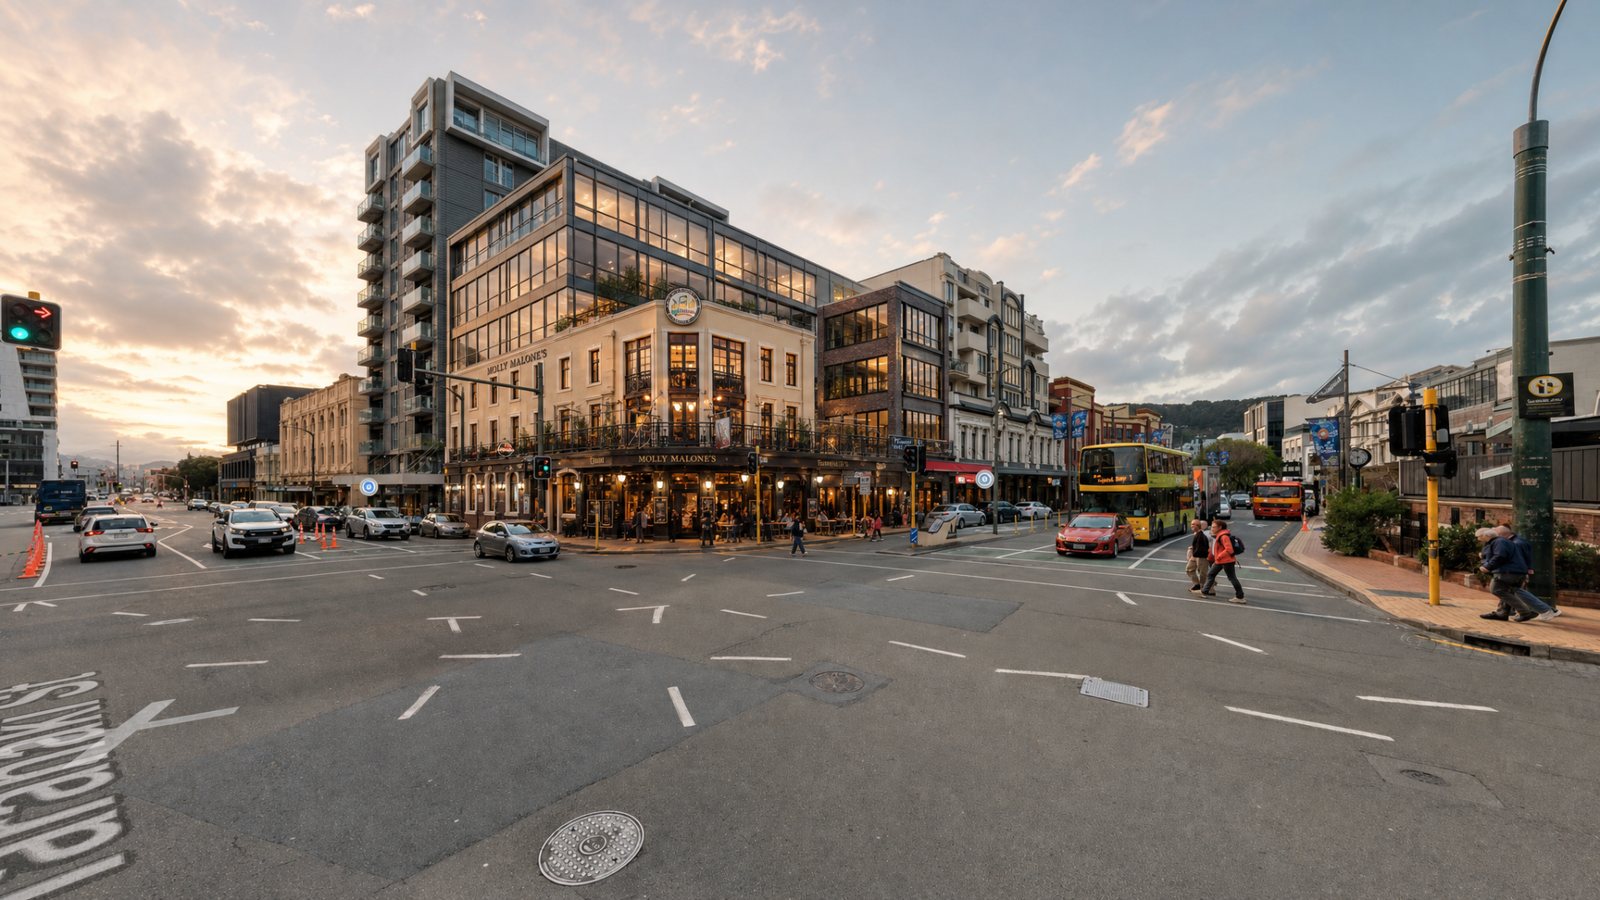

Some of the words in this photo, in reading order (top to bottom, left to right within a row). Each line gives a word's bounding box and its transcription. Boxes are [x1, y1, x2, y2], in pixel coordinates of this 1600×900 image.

[487, 362, 508, 375] MOLLY
[510, 349, 548, 369] MALONE'S
[638, 455, 668, 463] MOLLY
[671, 455, 717, 463] MALONE'S
